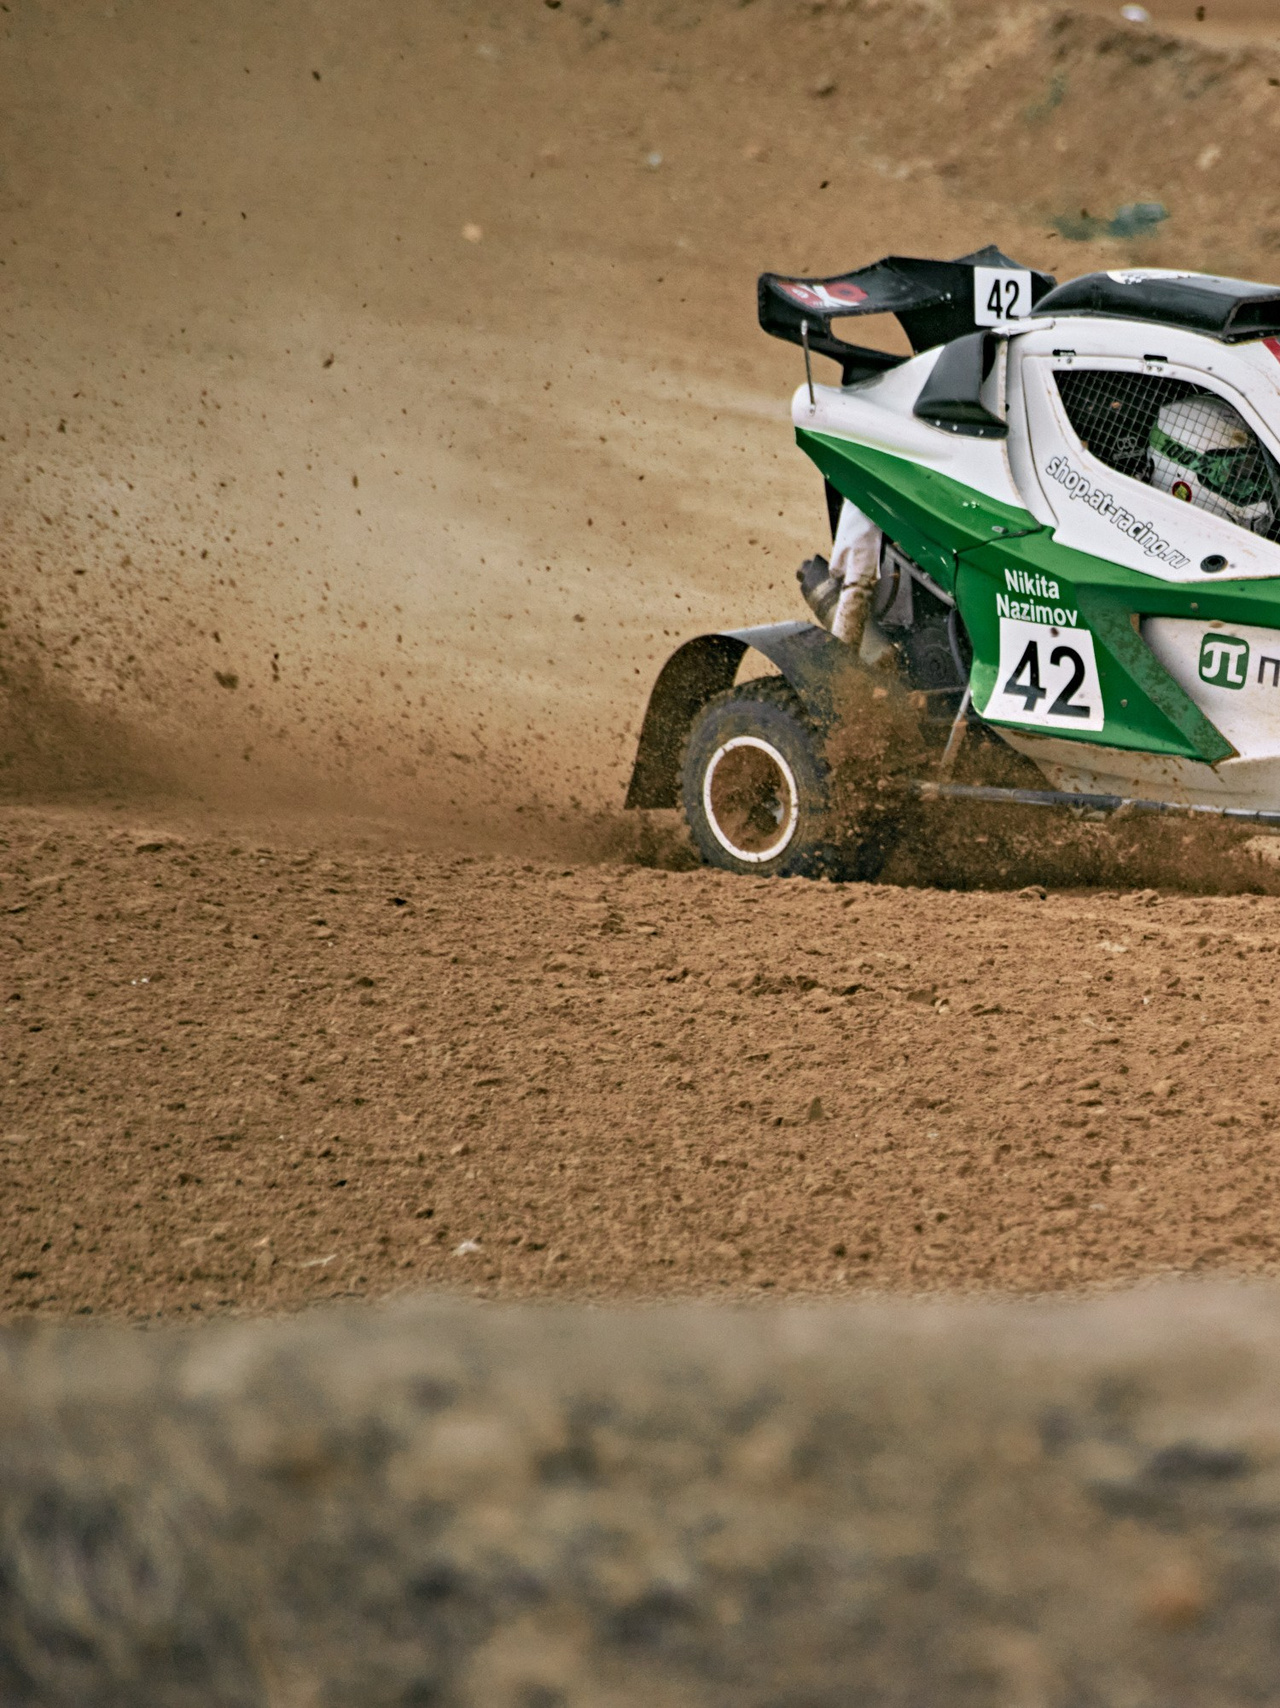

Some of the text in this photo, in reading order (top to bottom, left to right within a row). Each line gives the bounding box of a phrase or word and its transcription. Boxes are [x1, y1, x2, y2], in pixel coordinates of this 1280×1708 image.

[987, 278, 1020, 320] 42
[1160, 438, 1214, 474] 100%
[1045, 456, 1191, 569] shop.at-racing.ru
[1004, 568, 1060, 600] Nikita
[996, 593, 1078, 627] Nazimov
[1003, 640, 1091, 718] 42
